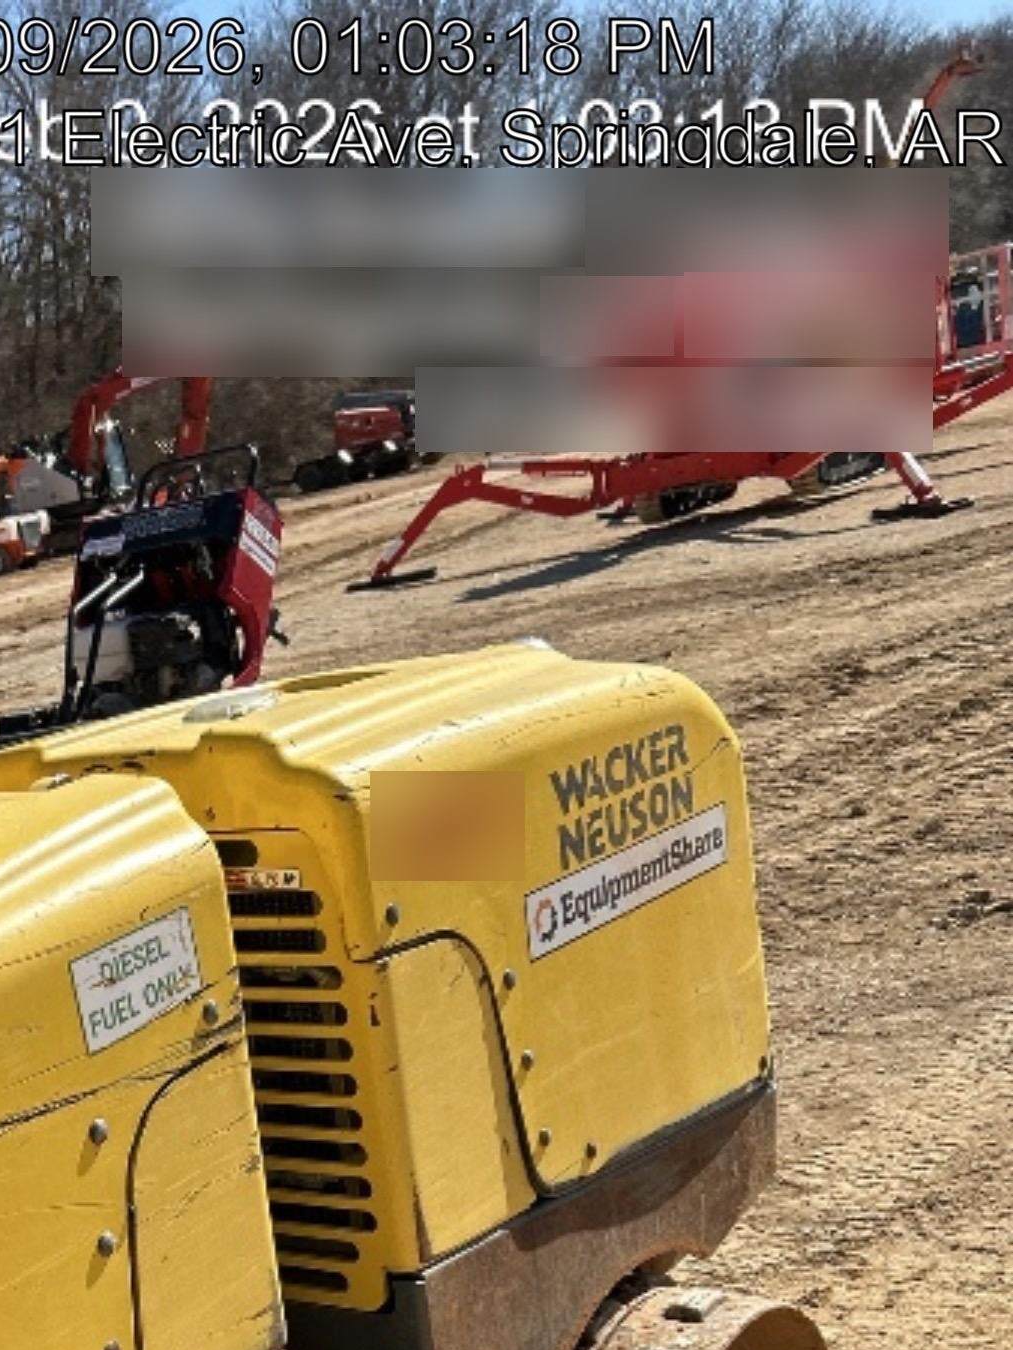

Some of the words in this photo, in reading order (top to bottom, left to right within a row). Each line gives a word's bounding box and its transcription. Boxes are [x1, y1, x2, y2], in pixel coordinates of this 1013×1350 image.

[548, 723, 690, 817] WACKER
[557, 775, 694, 871] NEUSON
[560, 826, 725, 928] EquipmentShare
[87, 991, 141, 1039] FUEL
[142, 963, 196, 1010] ONLY
[99, 935, 171, 983] DIESEL
